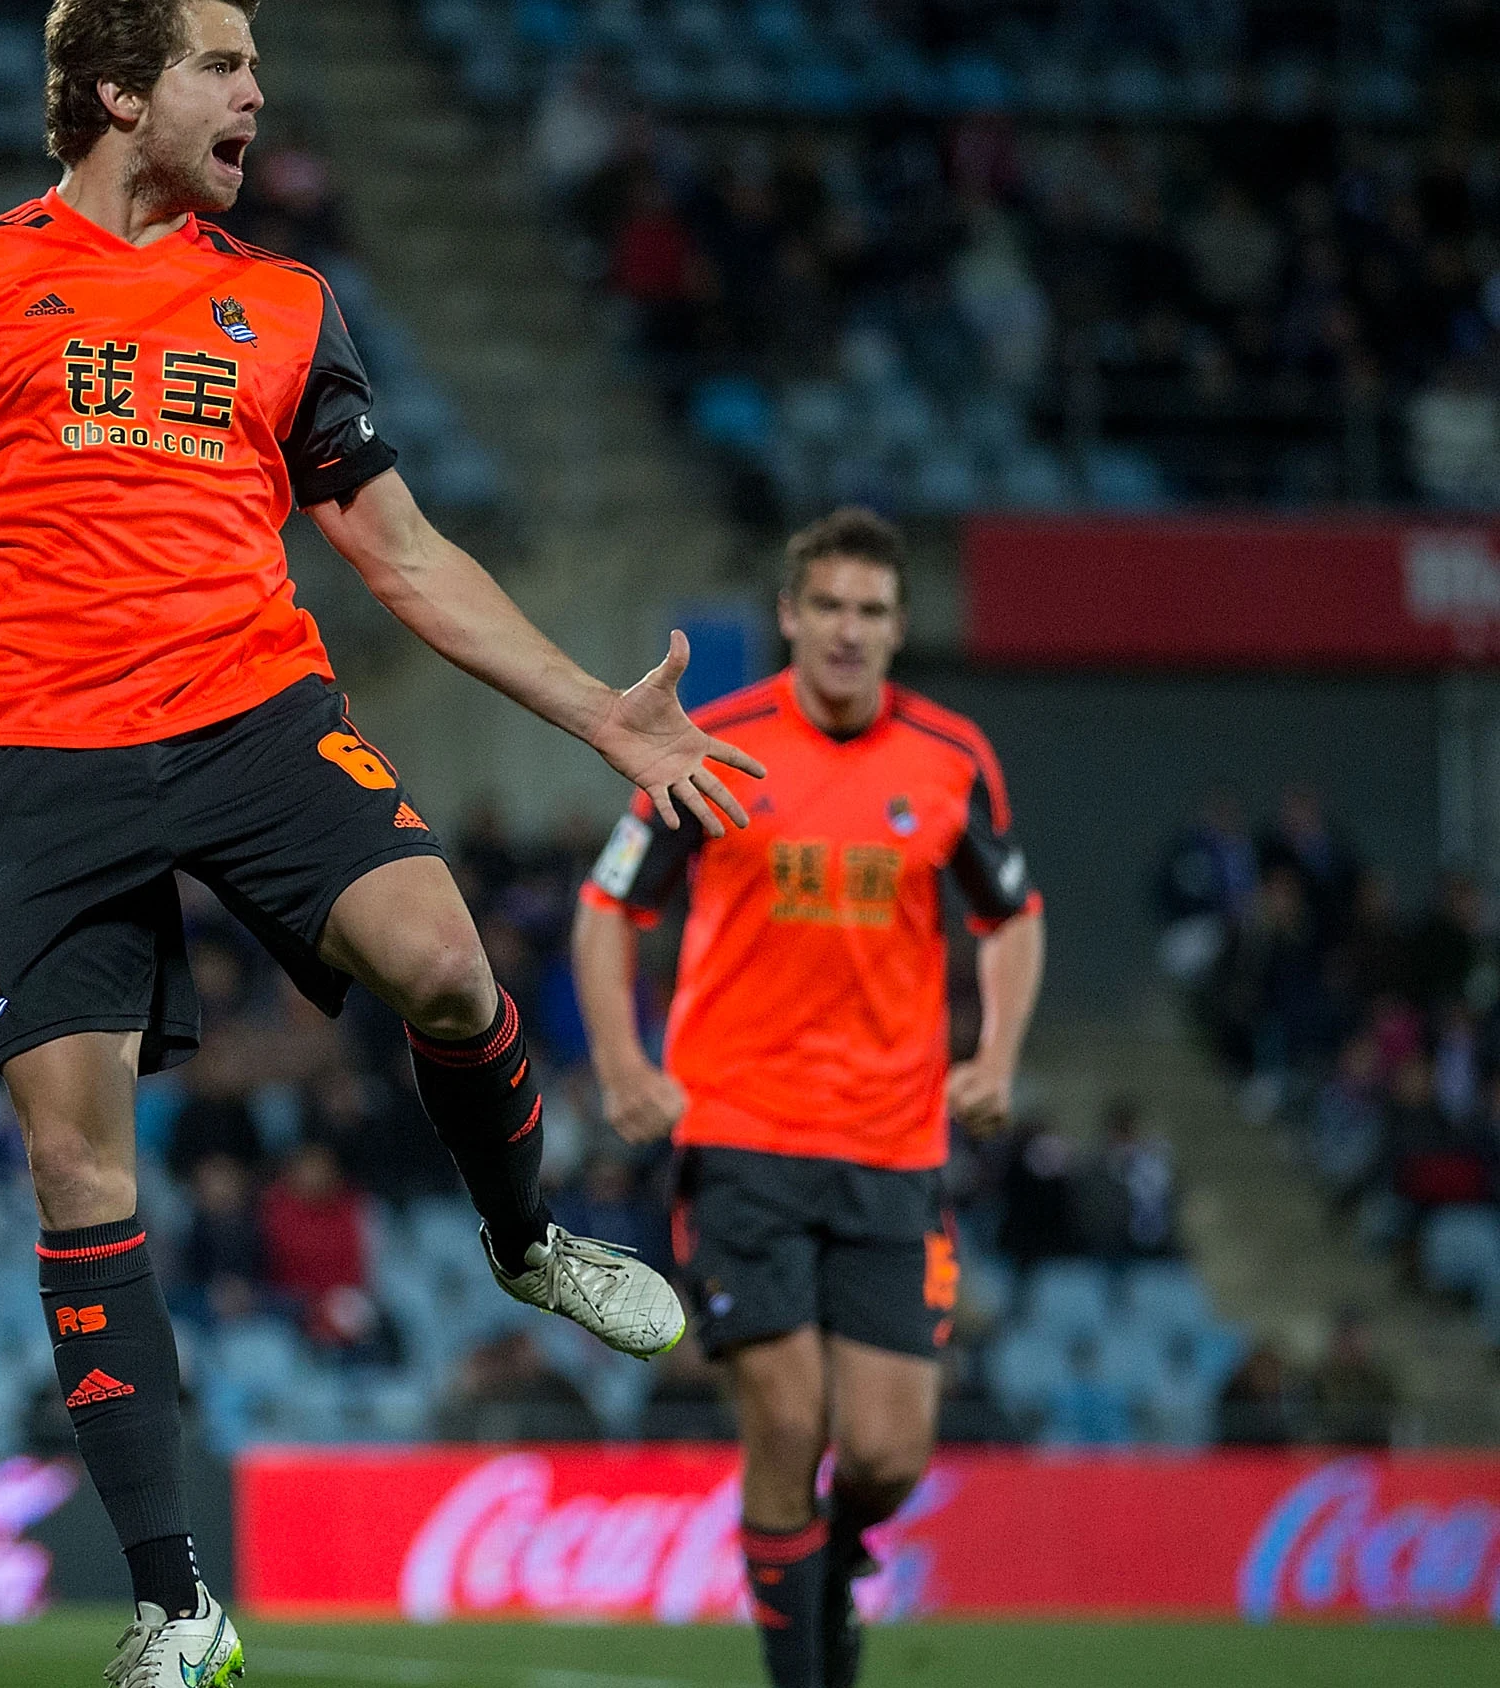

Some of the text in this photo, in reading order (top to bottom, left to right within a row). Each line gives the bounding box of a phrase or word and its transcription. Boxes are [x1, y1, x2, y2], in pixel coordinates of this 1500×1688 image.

[24, 306, 75, 317] adidas
[61, 338, 238, 430] 钱宝
[62, 421, 225, 463] qbao.com
[317, 731, 397, 790] 6
[56, 1304, 108, 1335] RS
[66, 1384, 136, 1408] adidas
